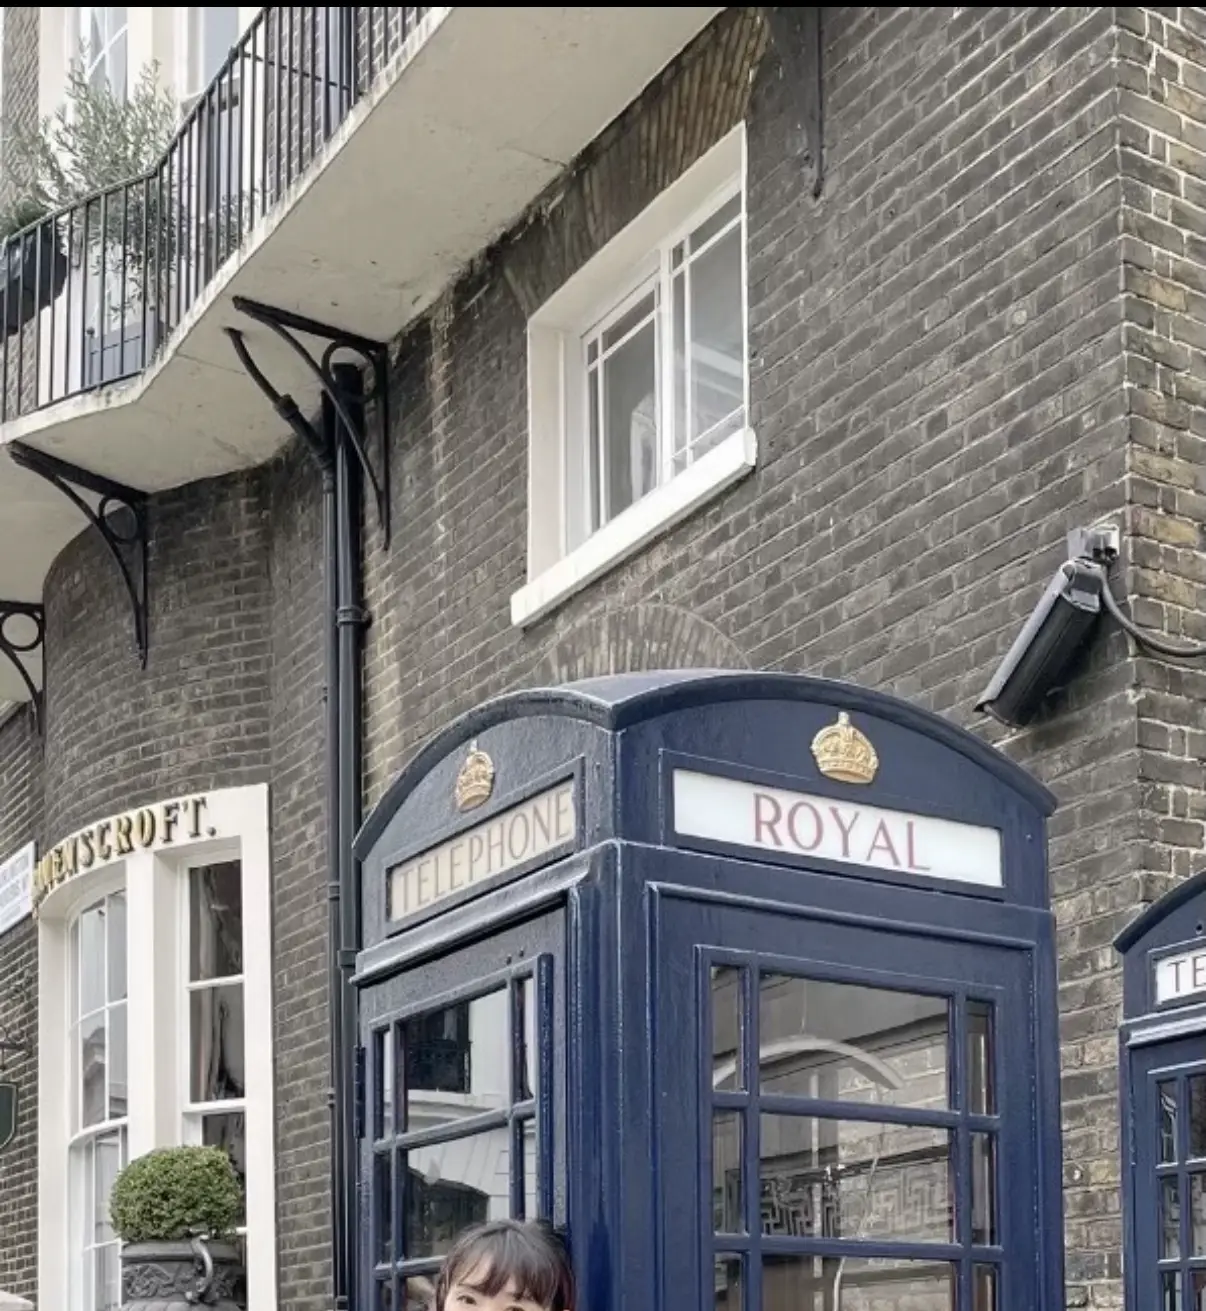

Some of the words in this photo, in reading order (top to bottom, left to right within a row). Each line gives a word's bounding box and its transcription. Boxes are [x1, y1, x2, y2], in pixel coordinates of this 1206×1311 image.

[31, 796, 217, 918] ENSCROFT.
[400, 786, 572, 913] TELEPHONE
[752, 791, 932, 873] ROYAL
[1167, 952, 1206, 993] TE
